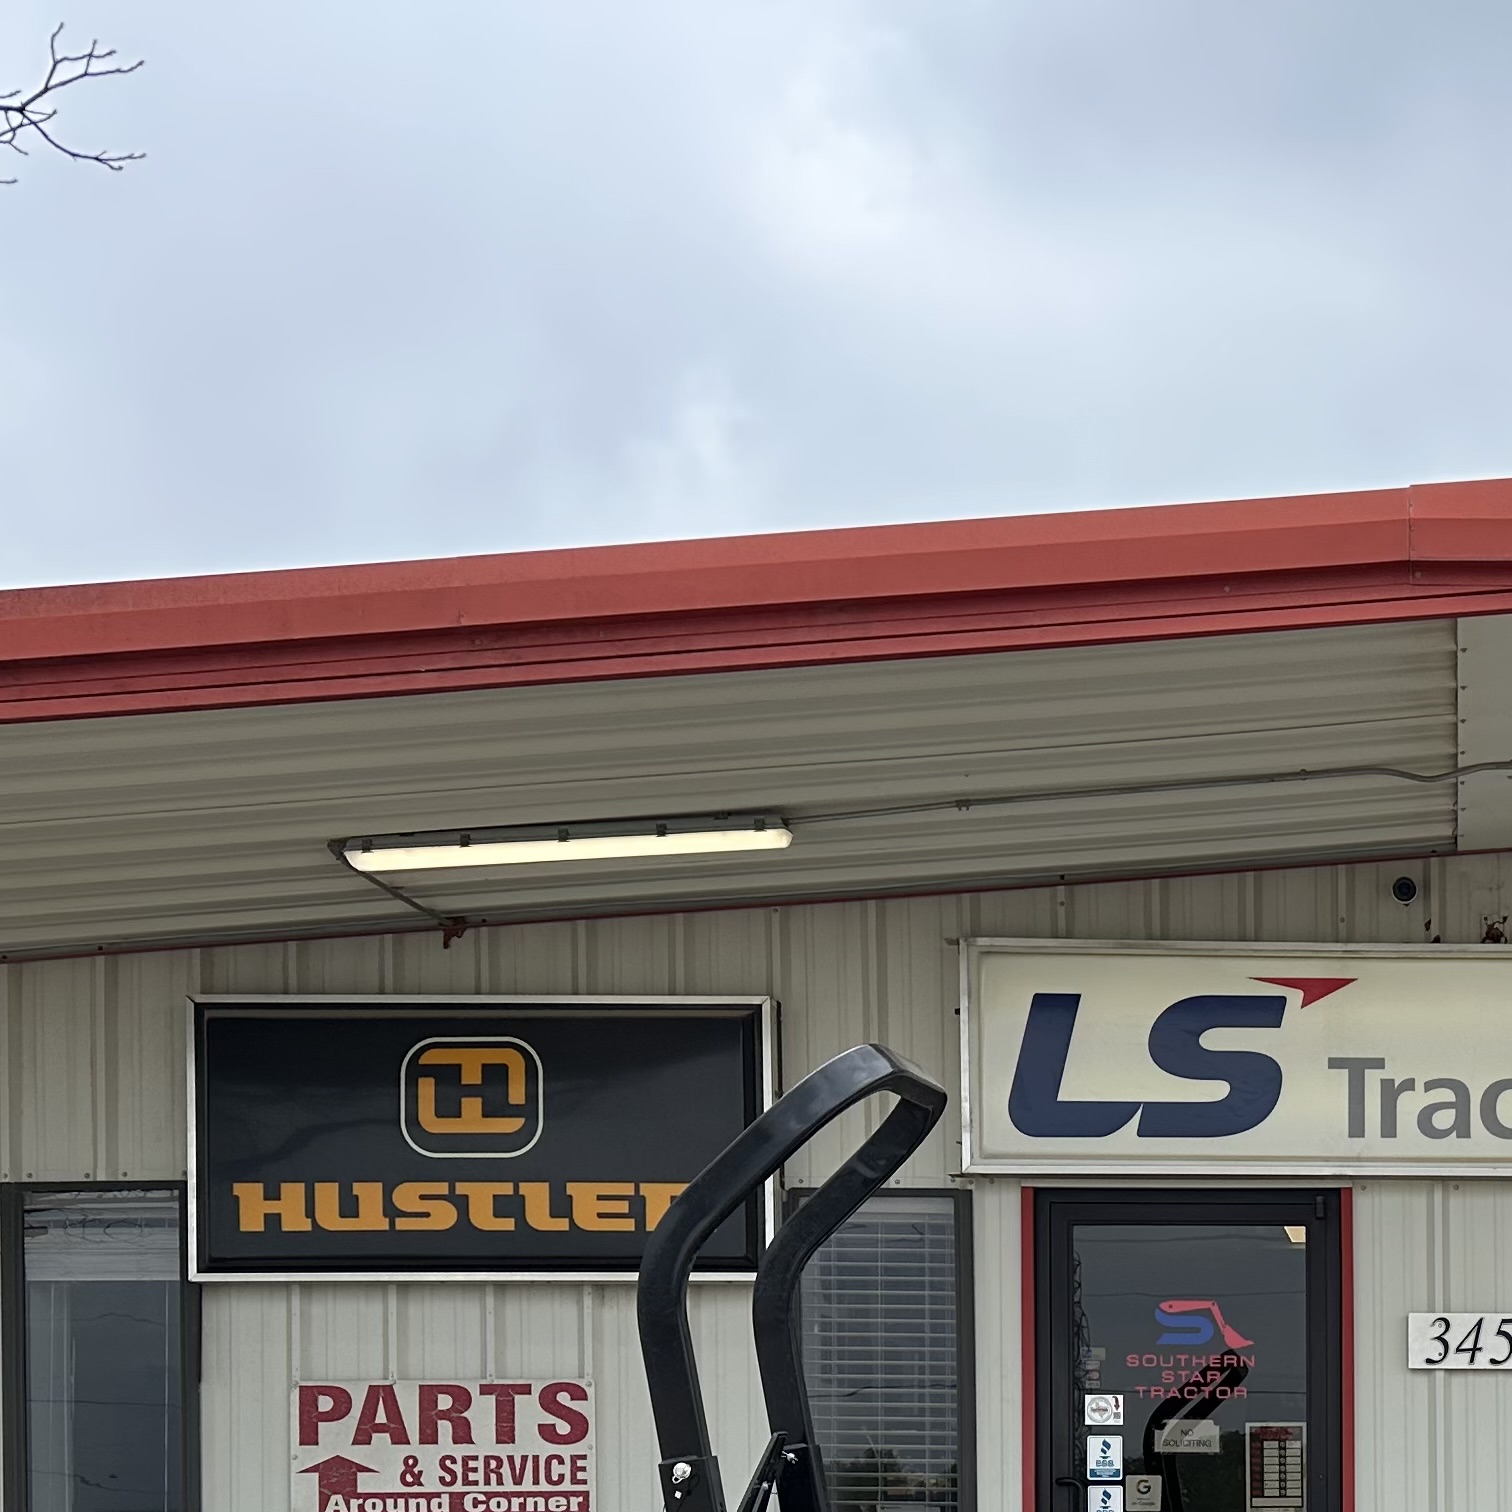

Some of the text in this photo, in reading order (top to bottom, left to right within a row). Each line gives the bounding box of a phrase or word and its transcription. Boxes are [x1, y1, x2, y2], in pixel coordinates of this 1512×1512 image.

[1008, 992, 1287, 1138] LS
[1125, 1353, 1256, 1368] SOUTHERN
[1161, 1370, 1222, 1384] STAR
[1134, 1386, 1249, 1400] TRACTOR
[298, 1382, 590, 1446] PARTS
[1180, 1428, 1194, 1437] NO
[399, 1454, 589, 1487] & SERVICE
